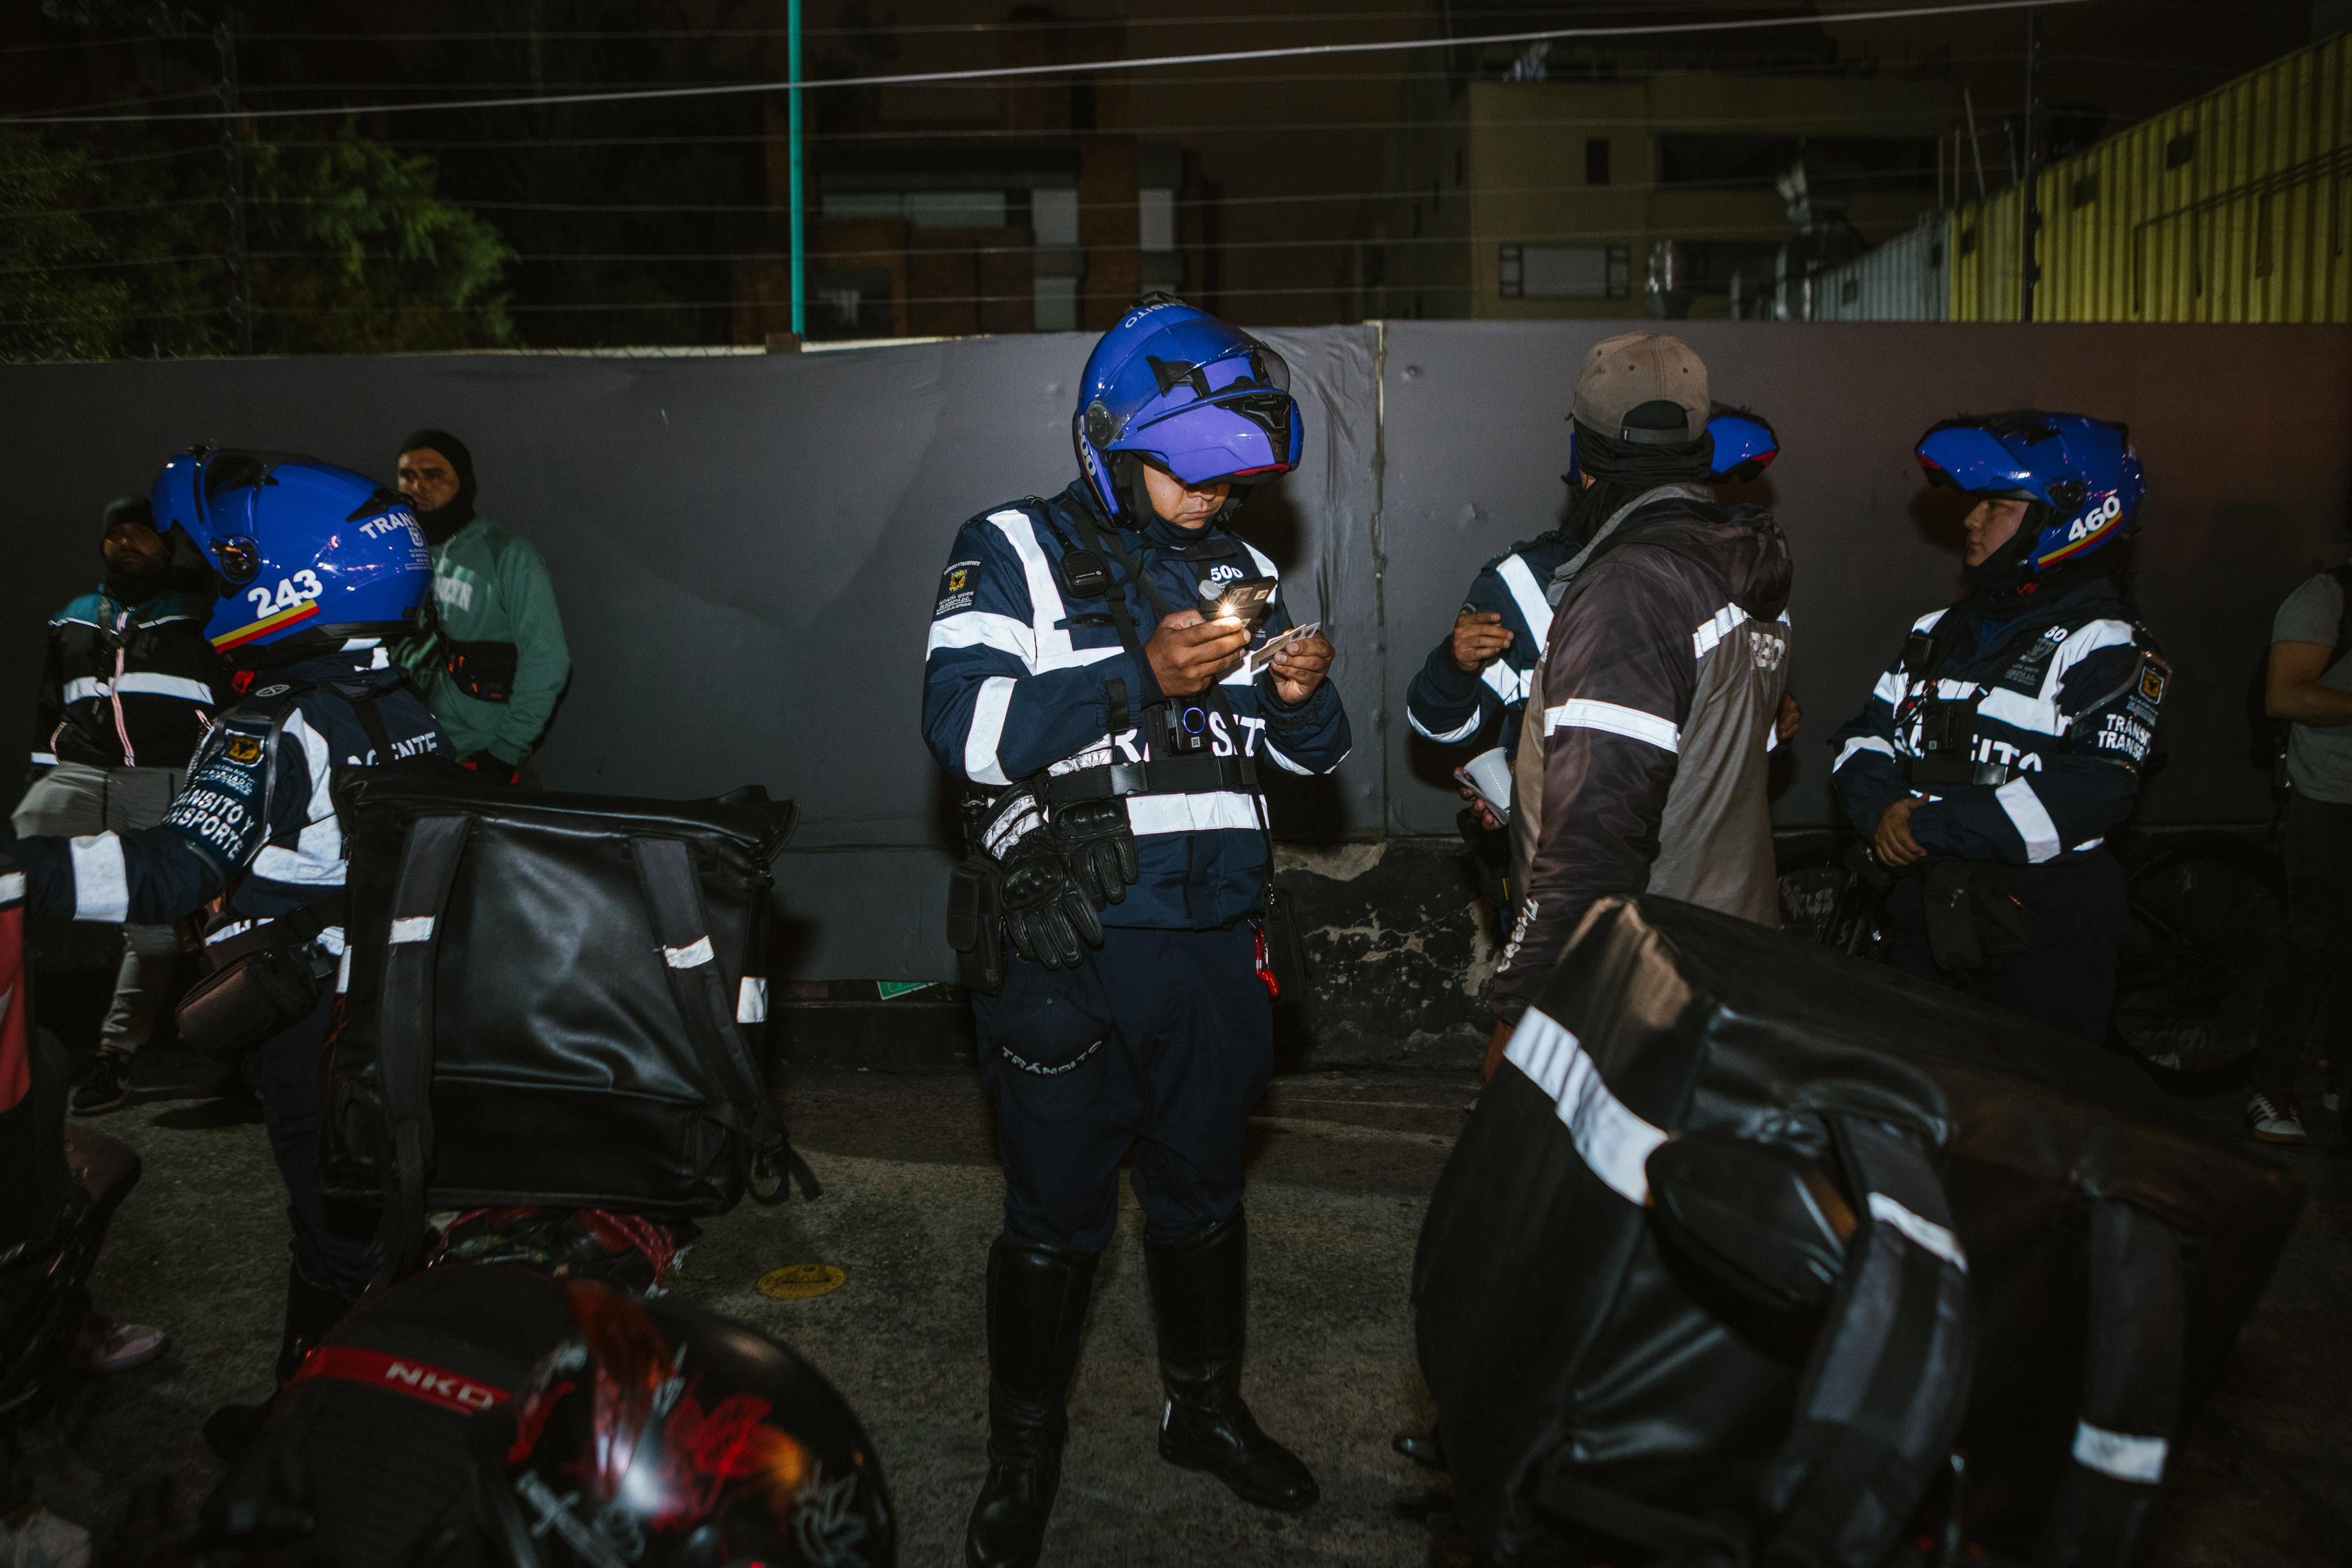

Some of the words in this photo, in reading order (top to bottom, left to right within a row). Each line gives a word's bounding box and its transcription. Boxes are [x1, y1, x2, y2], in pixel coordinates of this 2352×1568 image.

[2068, 495, 2120, 542] 460
[1210, 565, 1243, 581] 500
[248, 569, 323, 619] 243
[240, 815, 255, 837] Y
